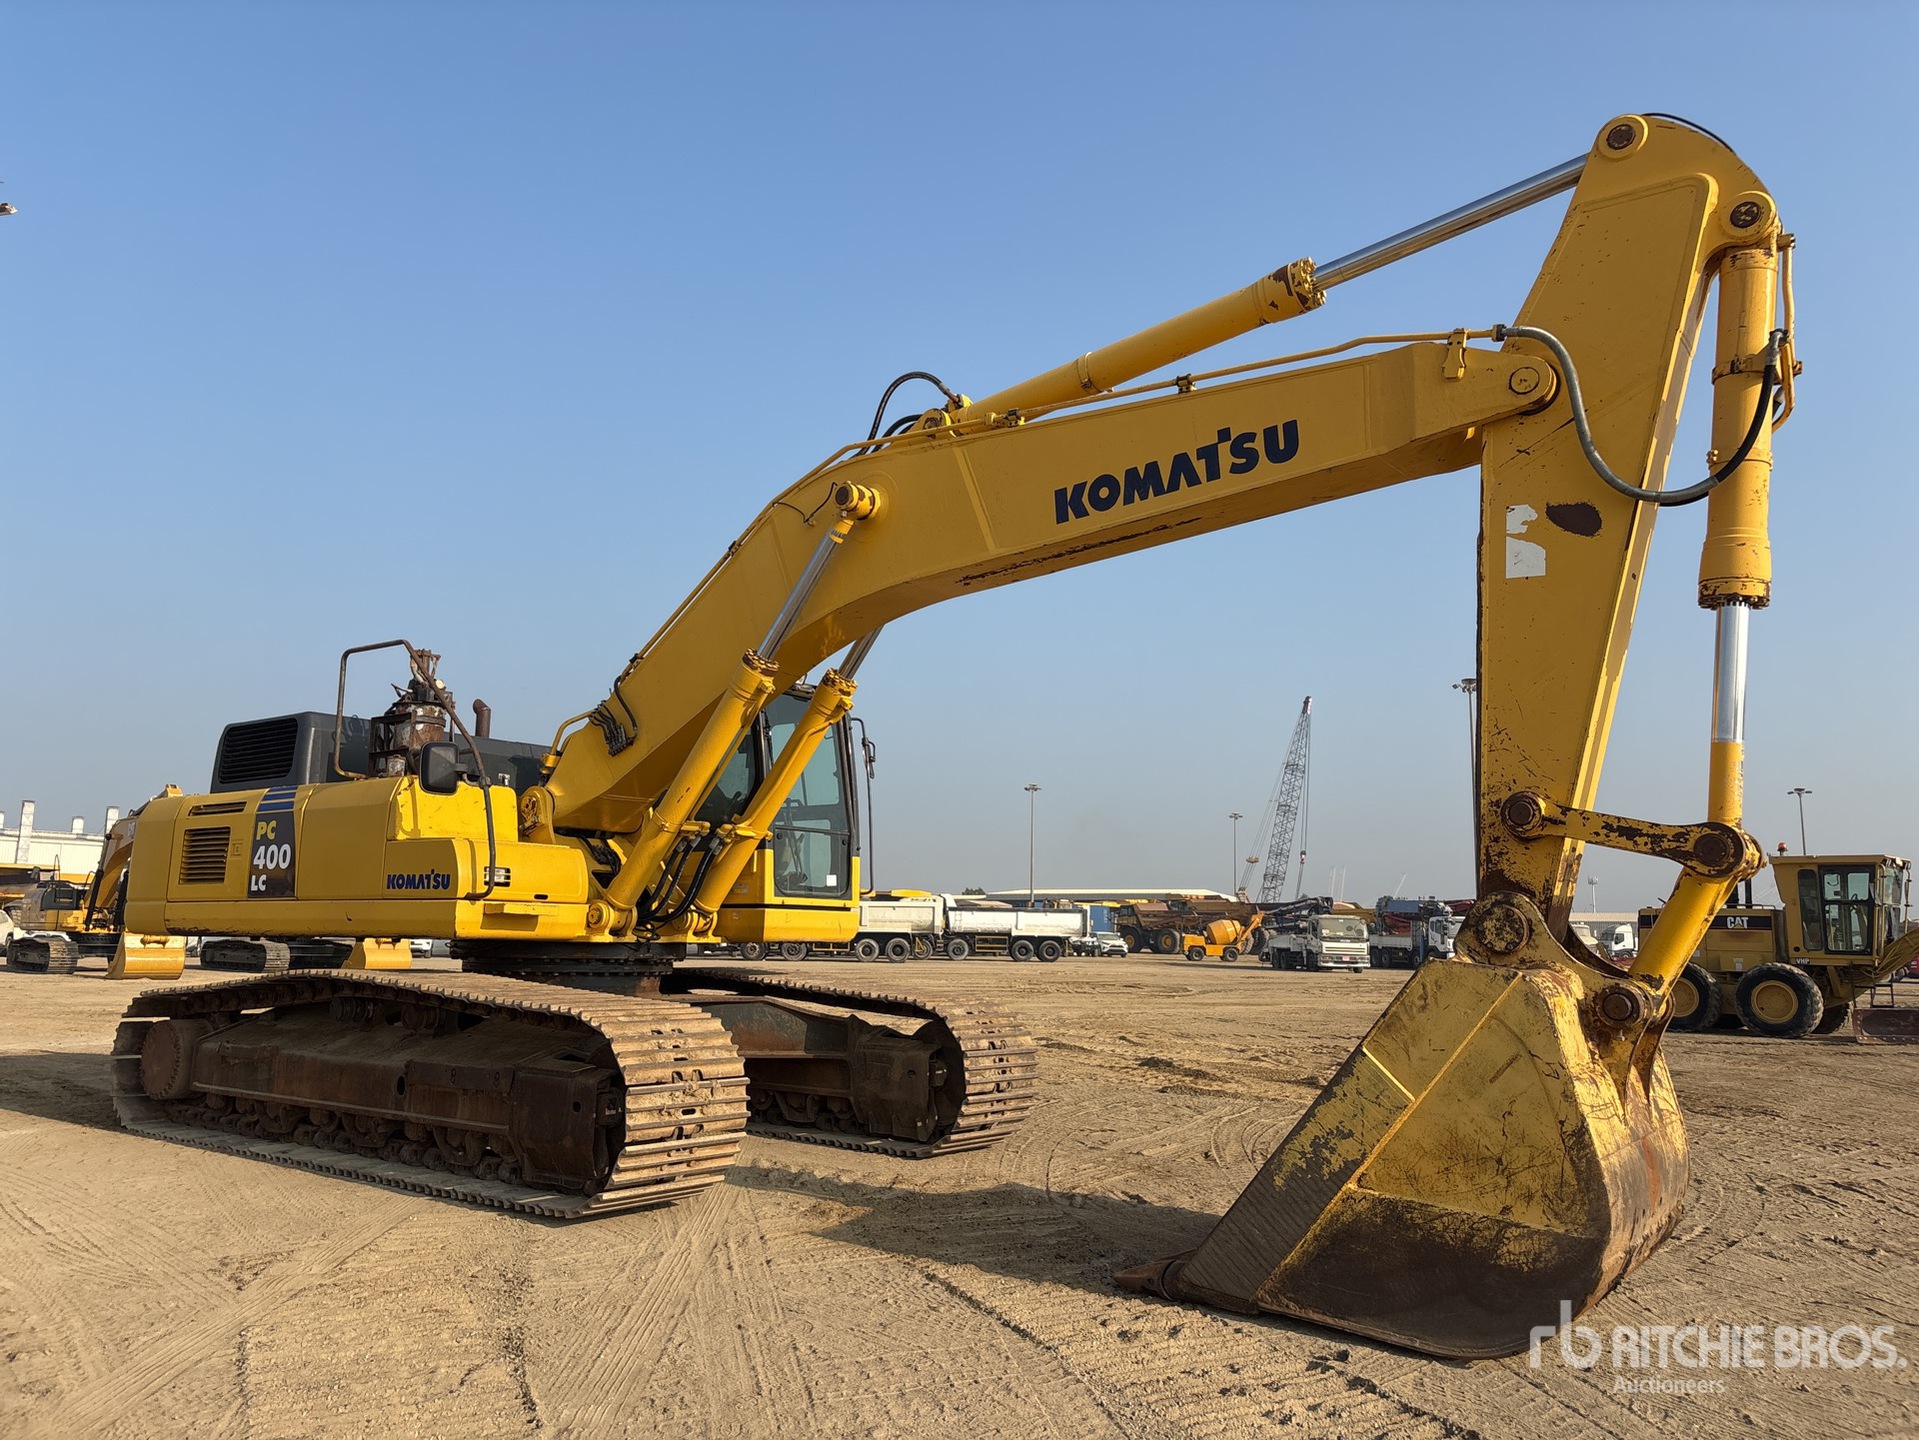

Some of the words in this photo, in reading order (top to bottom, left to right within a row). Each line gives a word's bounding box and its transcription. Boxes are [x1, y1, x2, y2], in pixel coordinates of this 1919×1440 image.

[1054, 419, 1300, 525] KOMATSU
[255, 820, 277, 840] PC
[253, 843, 291, 870] 400
[250, 874, 267, 891] LC
[386, 868, 451, 890] KOMATSU
[1726, 916, 1749, 929] CAT
